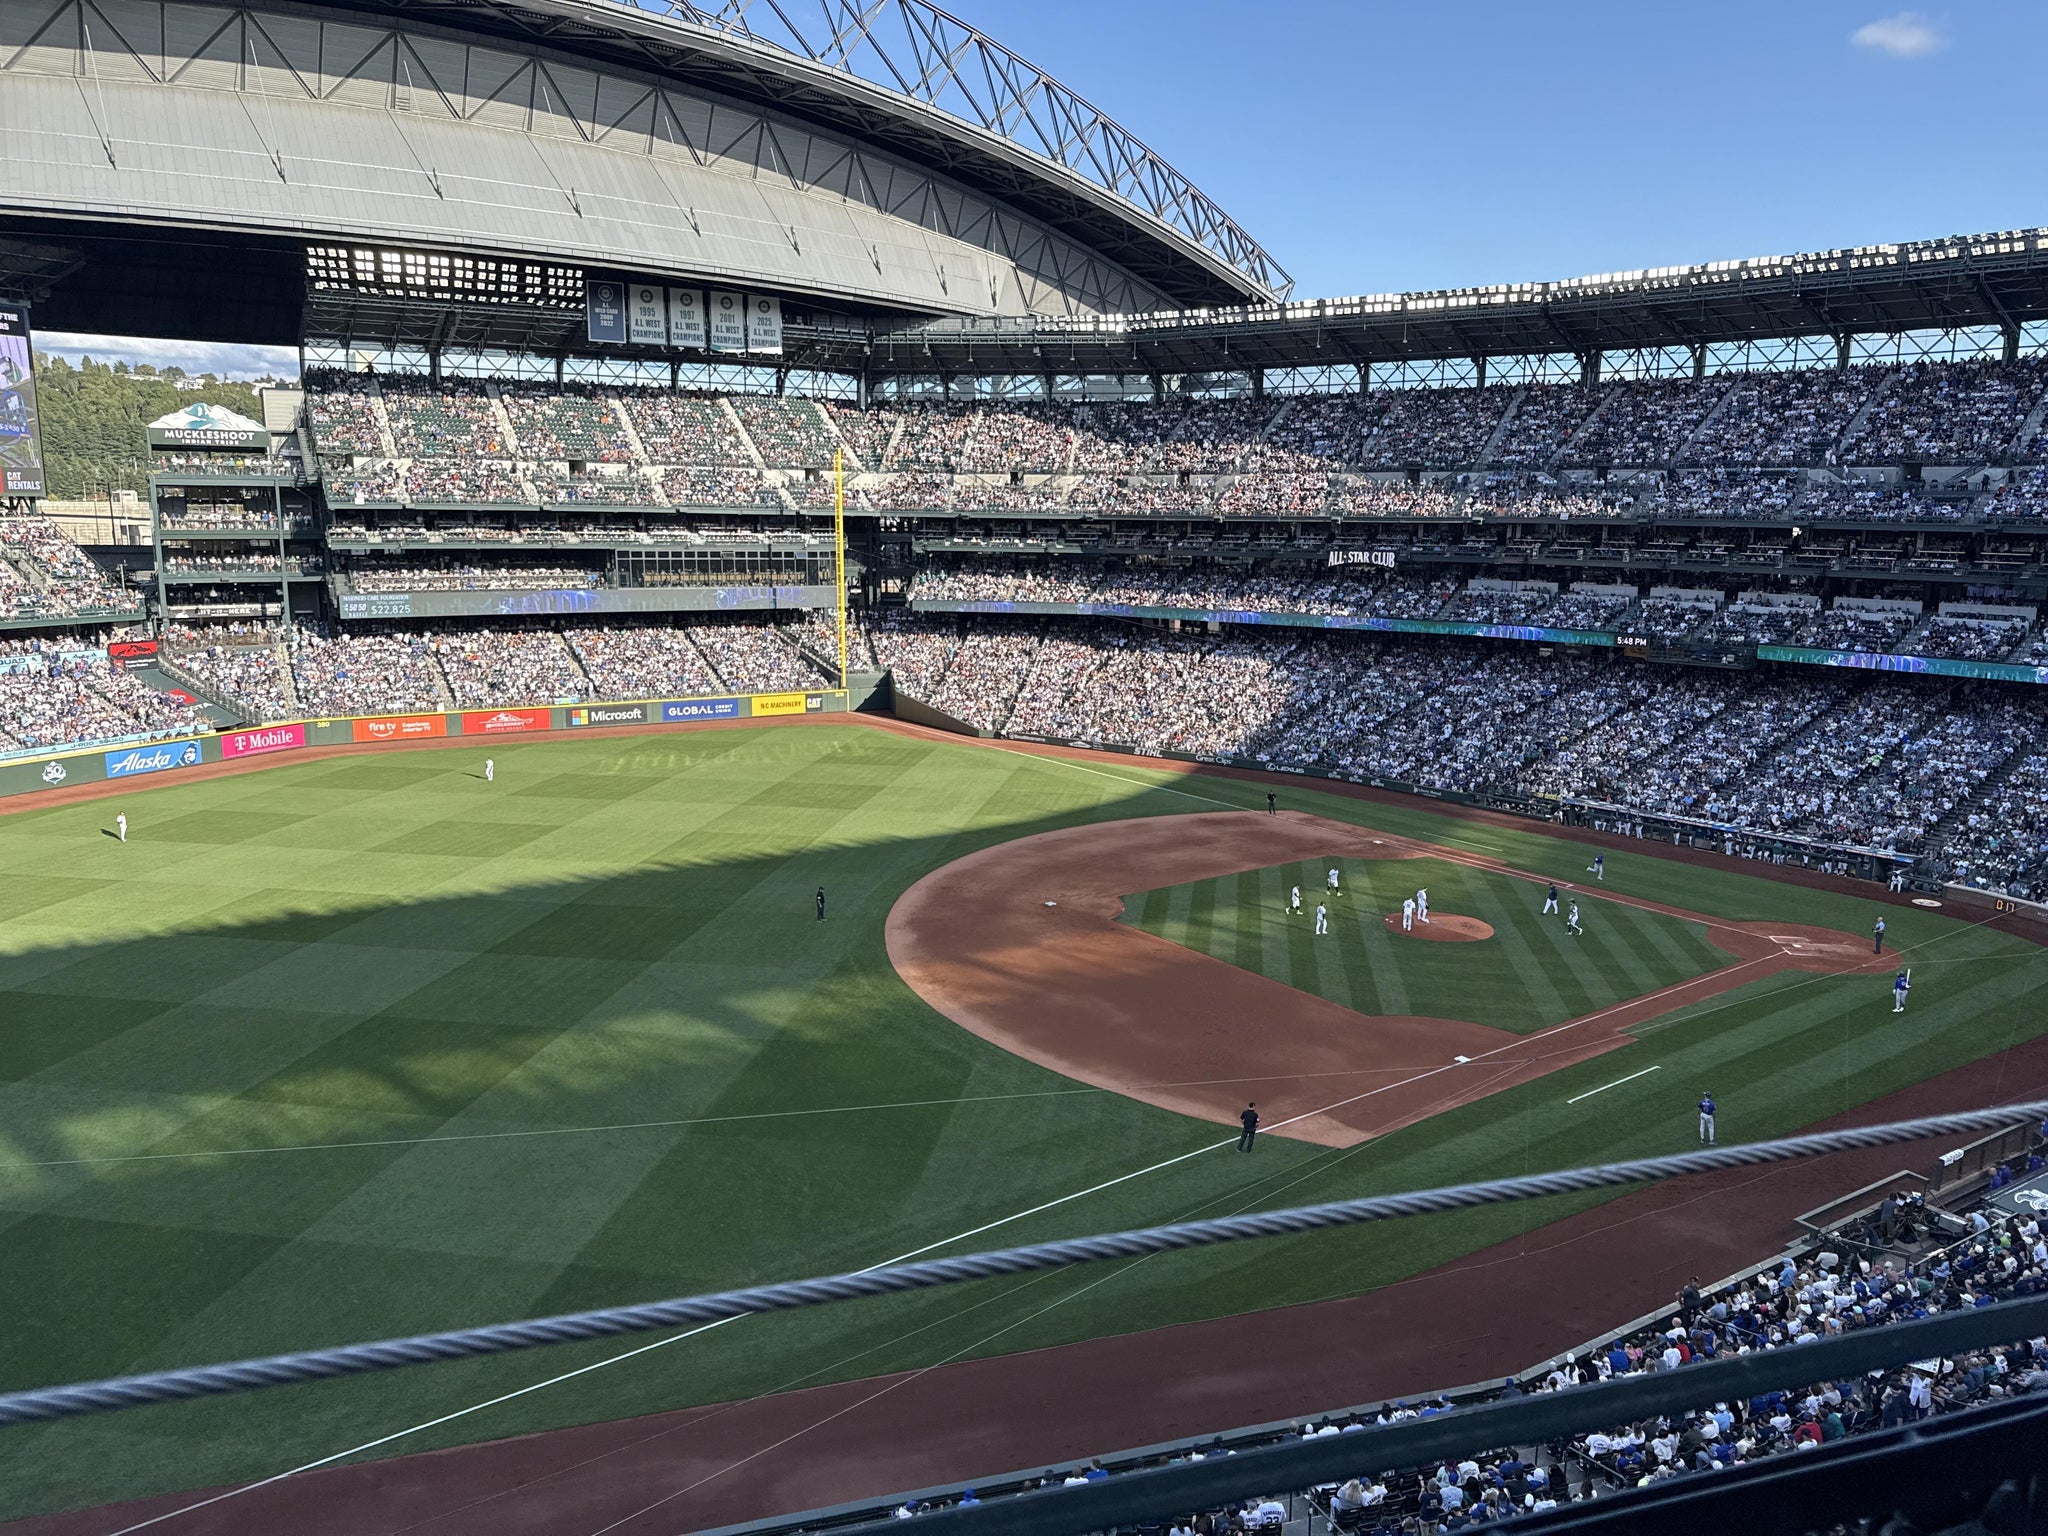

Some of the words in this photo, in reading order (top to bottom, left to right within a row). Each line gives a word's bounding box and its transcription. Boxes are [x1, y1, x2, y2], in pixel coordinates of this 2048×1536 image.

[639, 306, 656, 317] 1995
[680, 310, 695, 320] 1997
[635, 318, 644, 327] A.L.
[646, 320, 661, 328] WEST
[720, 313, 735, 324] 2001
[757, 316, 772, 326] 2025
[675, 322, 684, 330] A.L.
[685, 322, 700, 331] WEST
[716, 324, 724, 333] A.L.
[726, 326, 740, 334] WEST
[632, 329, 664, 339] CHAMPIONS
[672, 332, 704, 342] CHAMPIONS
[754, 328, 762, 336] A.L.
[763, 329, 776, 337] WEST
[712, 335, 743, 345] CHAMPIONS
[751, 338, 780, 347] CHAMPIONS
[164, 430, 254, 440] MUCKLESHOOT
[6, 472, 22, 480] CAT
[8, 480, 40, 490] RENTALS
[1372, 552, 1396, 568] CLUB
[371, 605, 410, 614] $22,825
[1617, 636, 1634, 646] 5:48
[1634, 638, 1647, 646] PM
[806, 698, 822, 708] CAT
[591, 708, 642, 722] Microsoft
[668, 705, 714, 716] GLOBAL
[368, 722, 386, 731] fire
[386, 722, 396, 730] tv
[249, 730, 294, 748] Mobile
[1134, 747, 1162, 758] STIHL
[111, 750, 171, 774] Alaska
[1196, 754, 1214, 762] Great
[1216, 756, 1232, 766] Clips
[1276, 766, 1304, 774] LEXUS
[2006, 902, 2015, 912] 17
